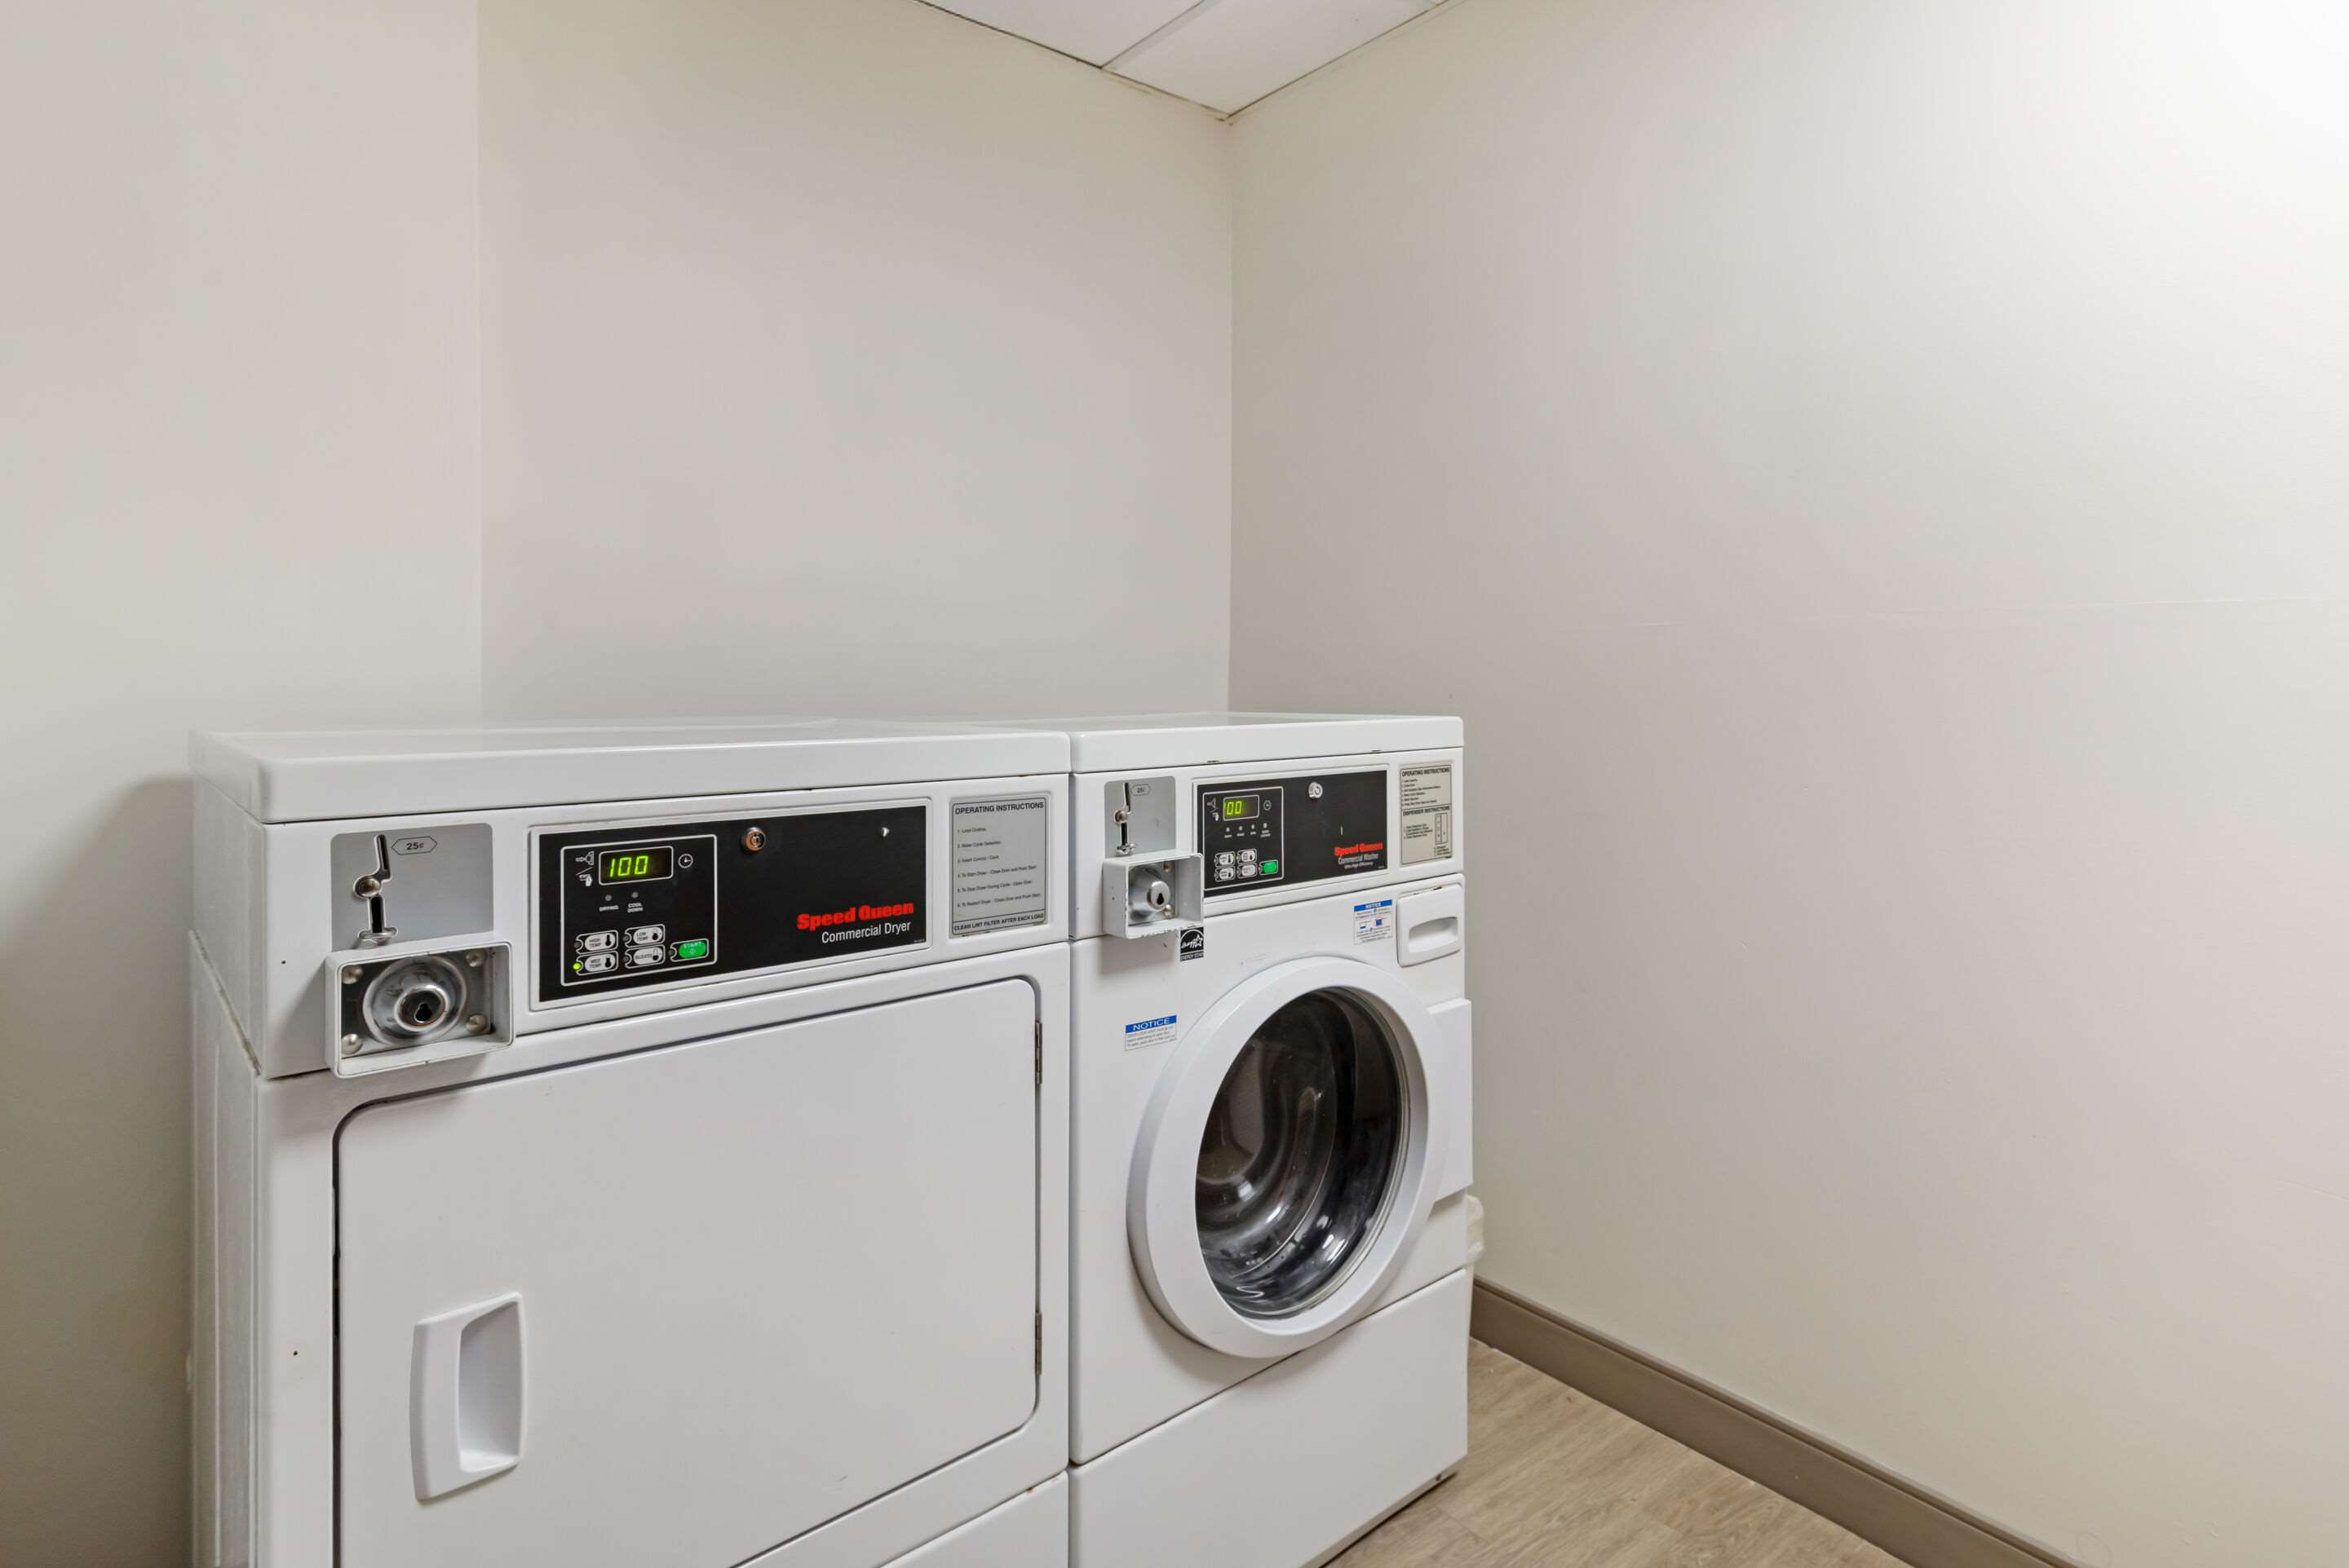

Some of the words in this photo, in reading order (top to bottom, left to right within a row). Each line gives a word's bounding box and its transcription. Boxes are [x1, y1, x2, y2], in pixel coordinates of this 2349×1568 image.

[954, 805, 994, 815] OPERATING
[996, 802, 1044, 811] INSTRUCTIONS
[405, 841, 425, 851] 25¢
[609, 855, 648, 878] 100
[795, 907, 856, 931] Speed
[858, 902, 914, 921] Queen
[821, 924, 882, 944] Commercial
[884, 921, 912, 936] Dryer
[1133, 1017, 1170, 1031] NOTICE
